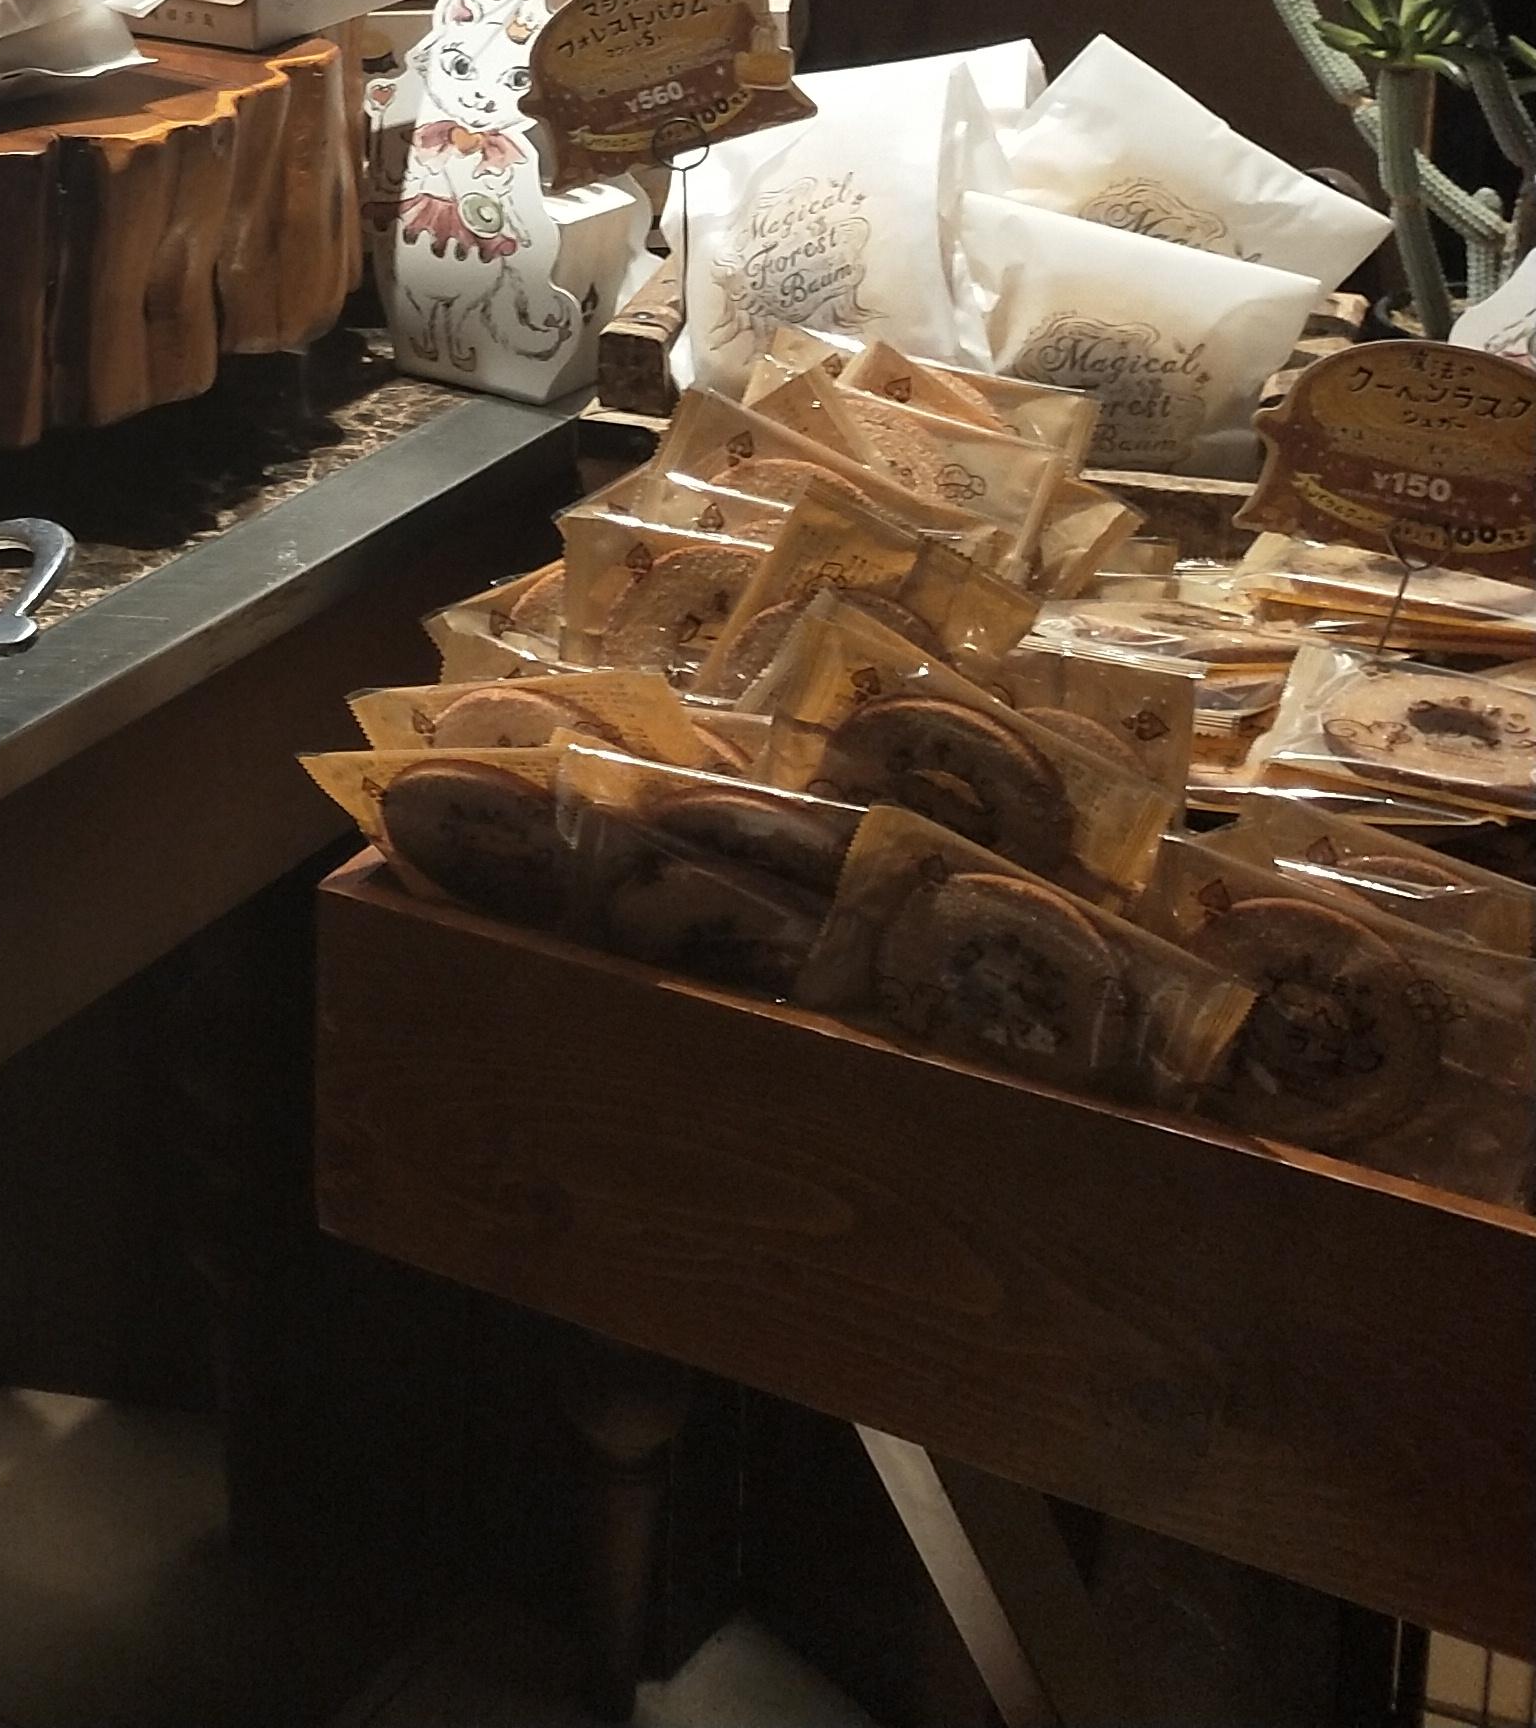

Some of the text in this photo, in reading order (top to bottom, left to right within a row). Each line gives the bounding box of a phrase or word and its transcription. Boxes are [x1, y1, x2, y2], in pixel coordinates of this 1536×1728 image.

[557, 0, 707, 58] フォレストバウム
[625, 81, 685, 113] ¥560
[745, 227, 836, 290] Forest
[1039, 334, 1206, 385] Magical
[1100, 395, 1171, 418] rest
[1348, 366, 1532, 420] クーヘンラスク
[1372, 470, 1453, 503] ¥150
